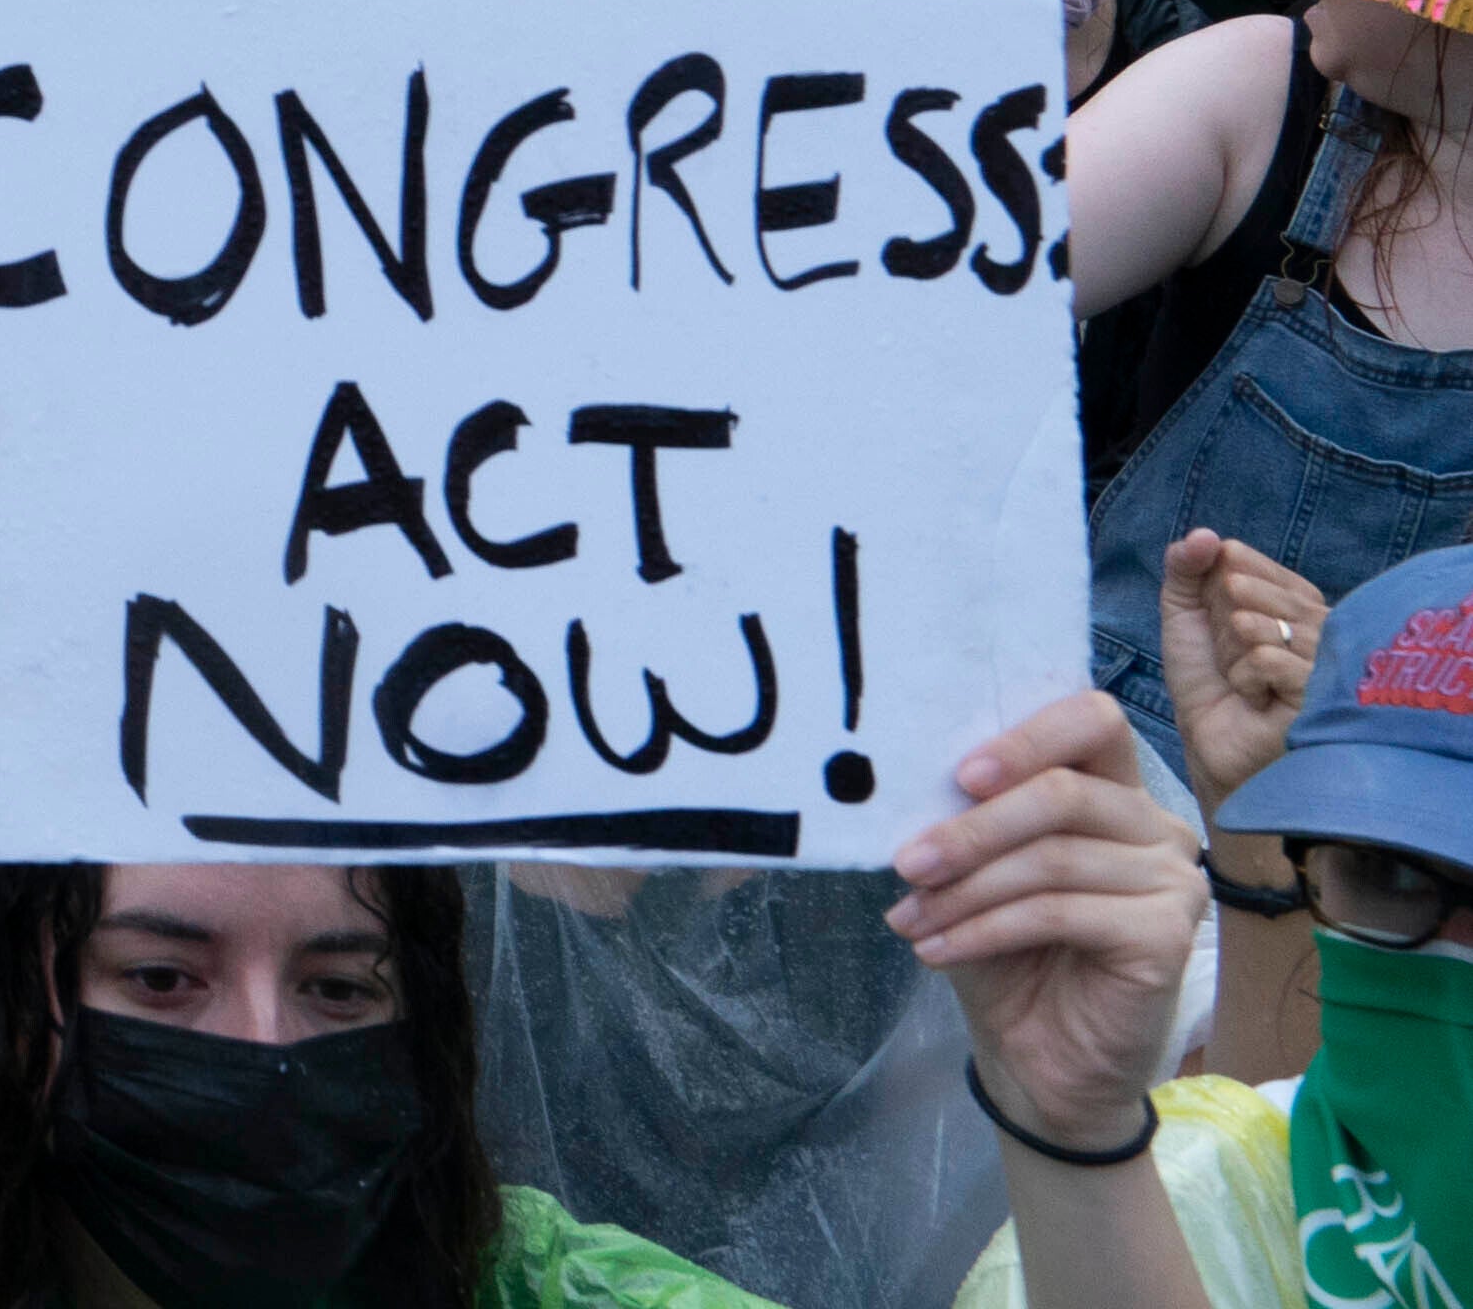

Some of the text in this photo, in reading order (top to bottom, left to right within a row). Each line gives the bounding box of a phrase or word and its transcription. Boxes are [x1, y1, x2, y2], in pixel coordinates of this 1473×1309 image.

[285, 380, 739, 586] ACT
[120, 527, 875, 807] NOW!
[1358, 650, 1473, 701] STRUC
